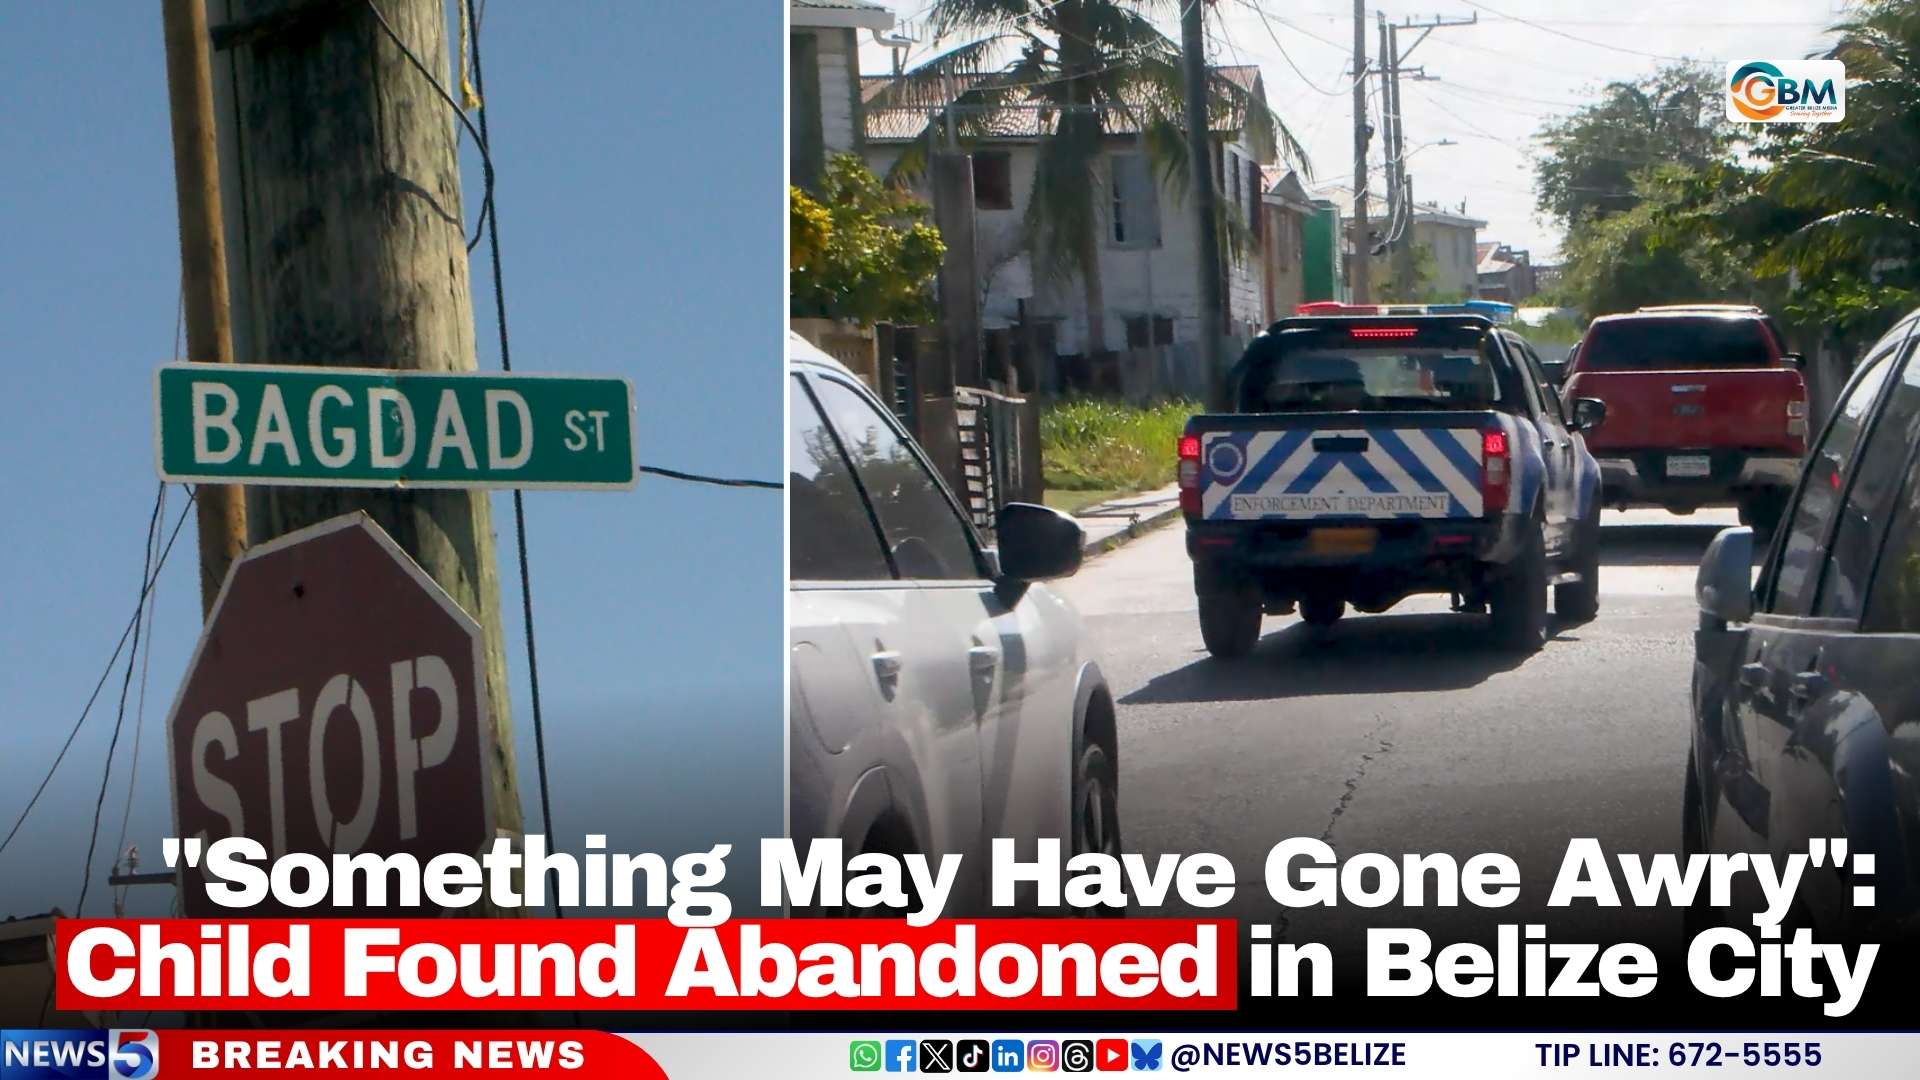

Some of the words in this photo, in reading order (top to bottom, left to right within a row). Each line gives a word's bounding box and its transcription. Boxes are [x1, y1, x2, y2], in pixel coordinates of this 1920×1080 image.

[191, 381, 534, 470] BAGDAD
[563, 410, 609, 452] ST
[1233, 496, 1340, 512] ENFORCEMENT
[1347, 495, 1447, 511] DEPARTMENT
[191, 655, 459, 872] STOP
